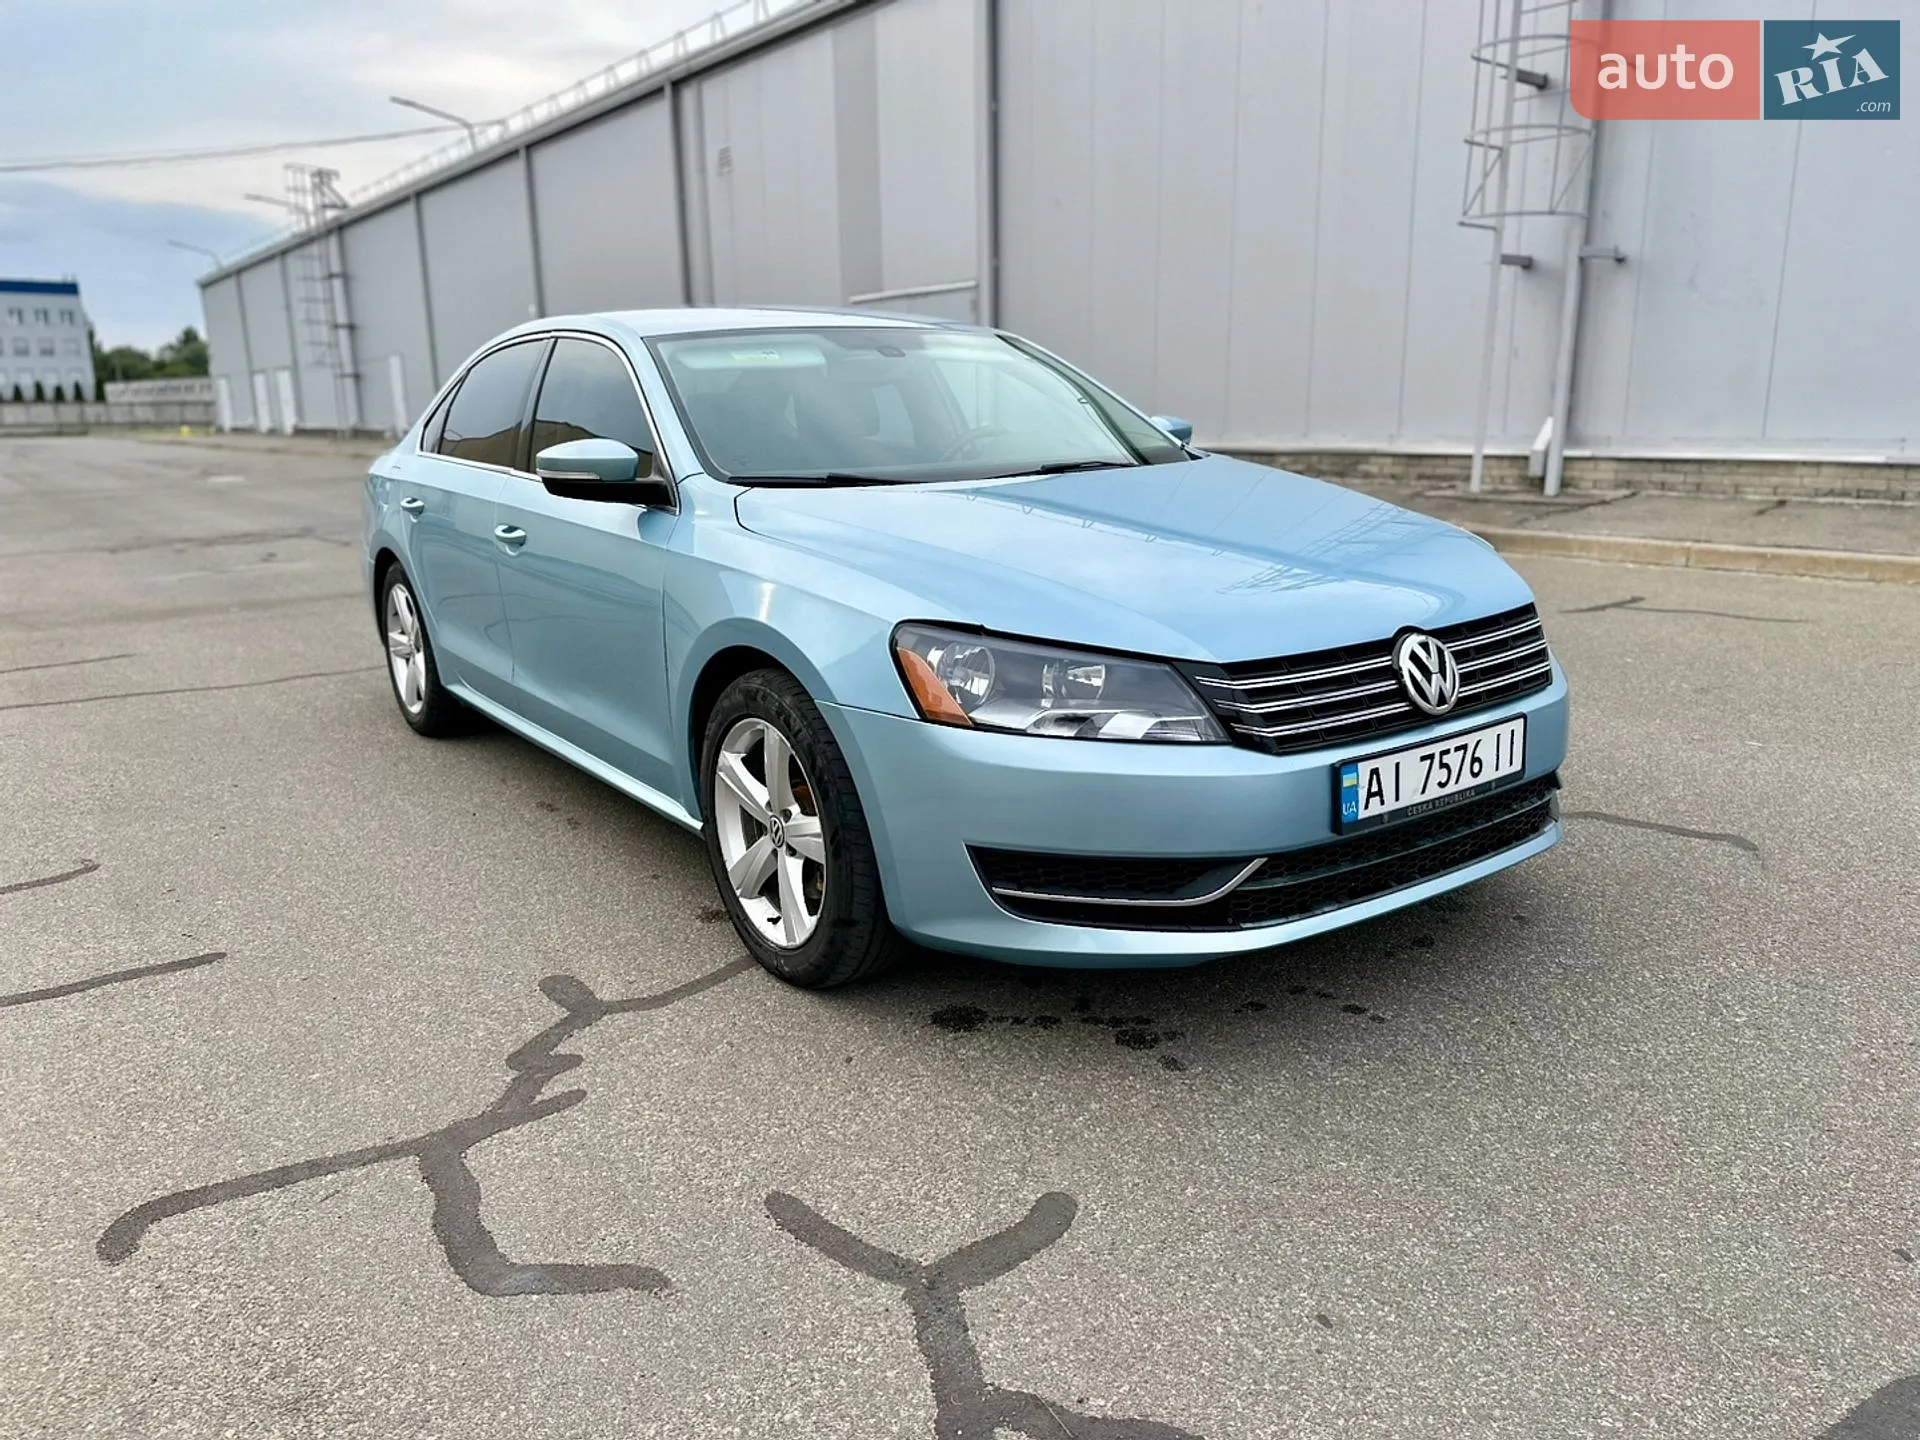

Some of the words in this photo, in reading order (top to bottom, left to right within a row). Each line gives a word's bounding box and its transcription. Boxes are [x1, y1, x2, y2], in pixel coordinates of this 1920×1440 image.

[1364, 762, 1400, 810] AI
[1420, 739, 1482, 795] 7576
[1495, 729, 1515, 772] II
[1342, 801, 1357, 815] UA
